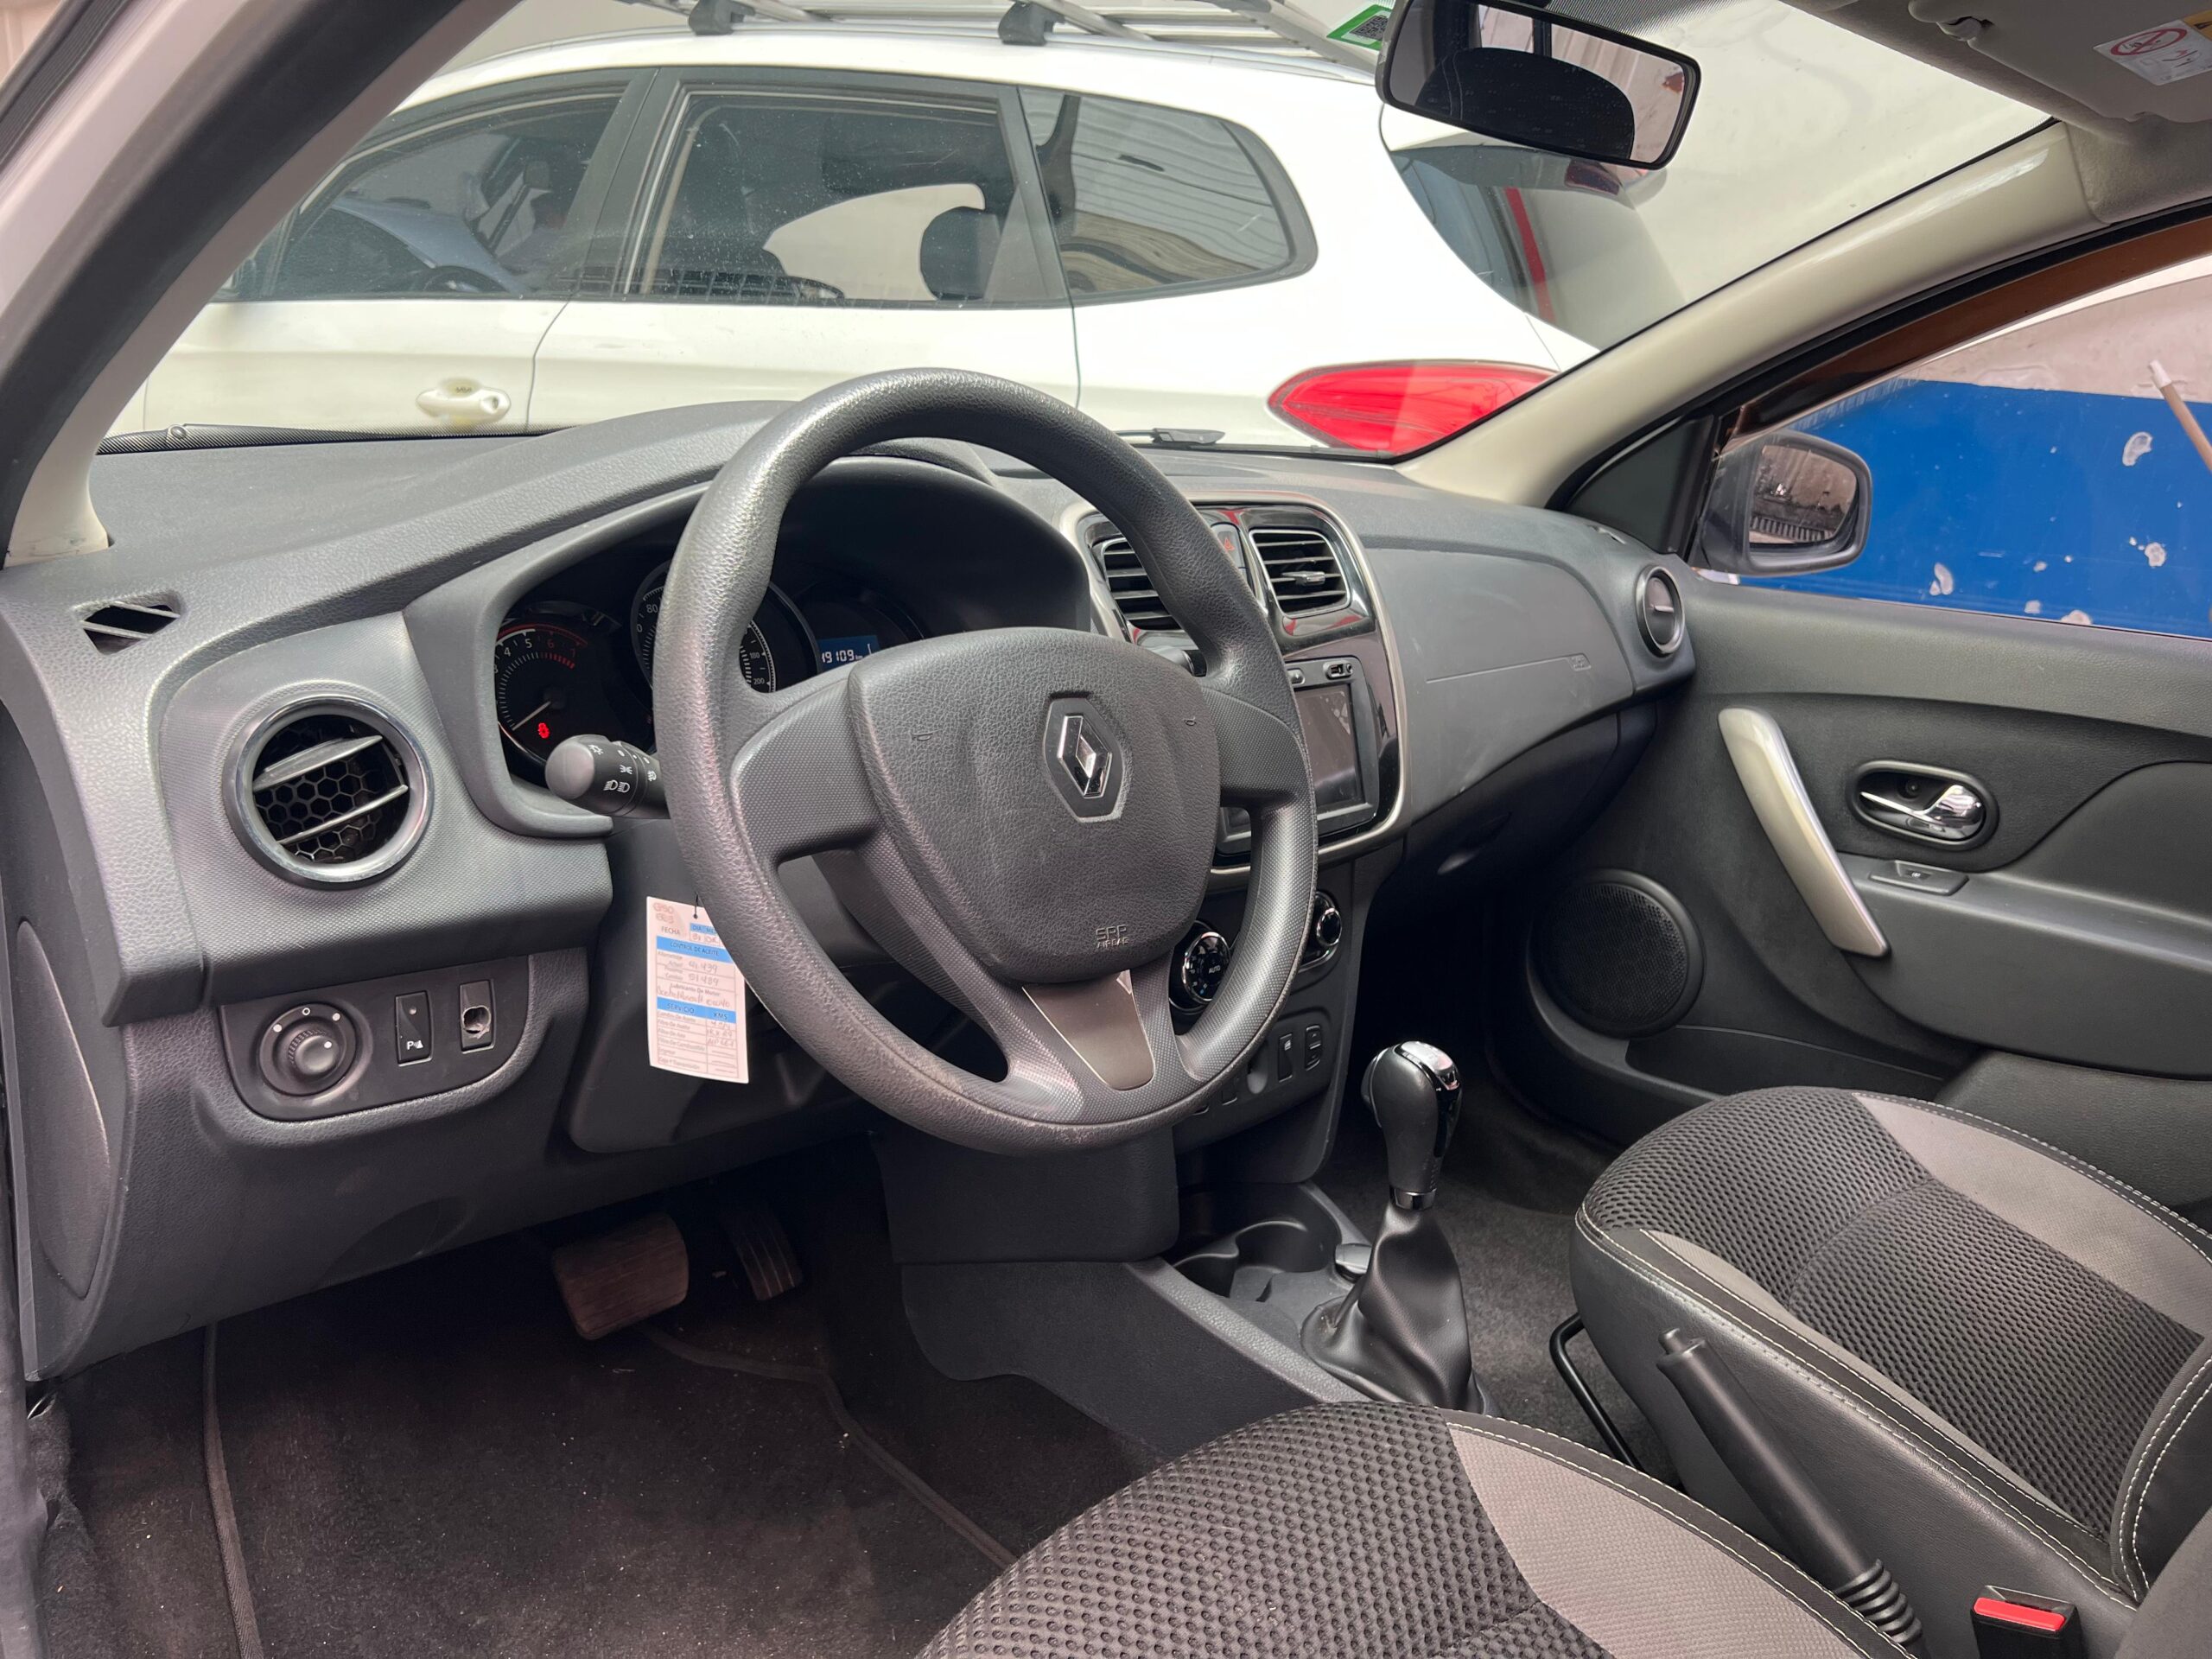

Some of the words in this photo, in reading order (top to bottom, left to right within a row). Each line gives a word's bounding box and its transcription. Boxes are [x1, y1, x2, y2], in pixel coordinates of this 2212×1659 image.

[646, 604, 658, 613] 80
[524, 639, 532, 648] 5
[547, 639, 555, 649] 6
[504, 647, 512, 657] 4
[661, 925, 681, 936] FECHA
[670, 941, 692, 951] CONTROL
[702, 948, 719, 957] ACEITE
[1209, 965, 1221, 974] AUTO
[666, 1002, 695, 1014] SERVICIO
[714, 1012, 728, 1020] KMS
